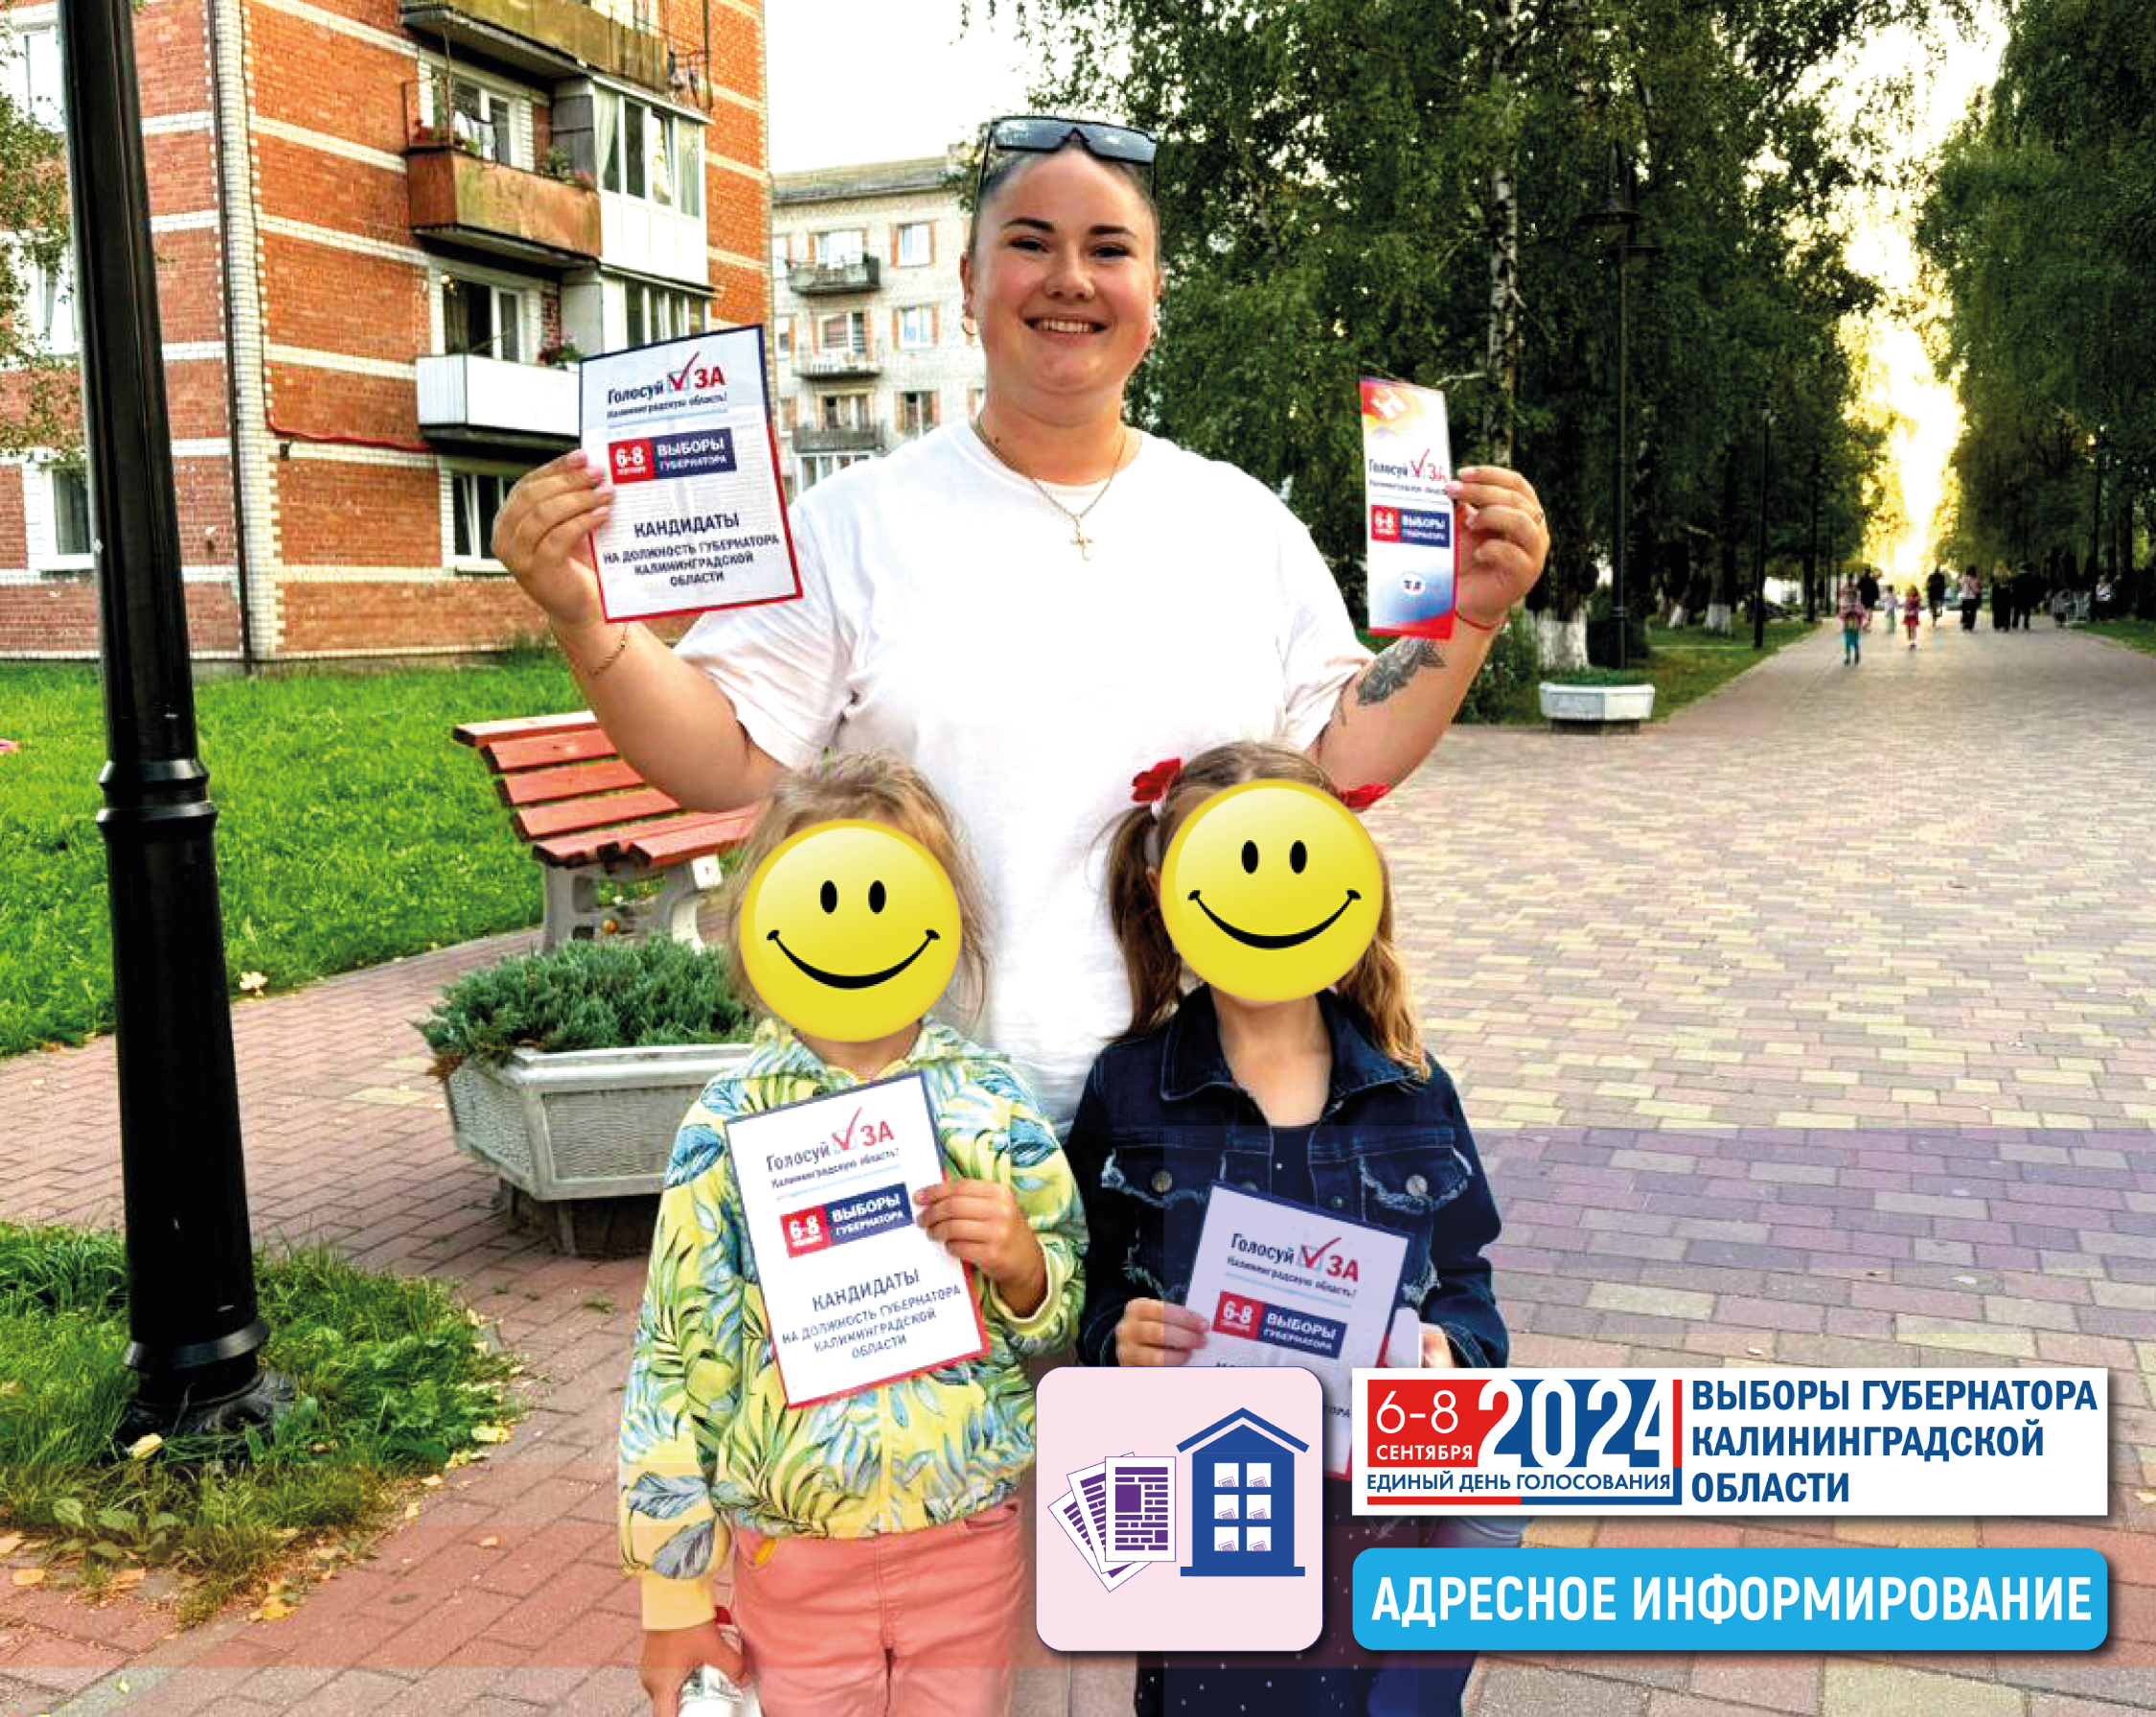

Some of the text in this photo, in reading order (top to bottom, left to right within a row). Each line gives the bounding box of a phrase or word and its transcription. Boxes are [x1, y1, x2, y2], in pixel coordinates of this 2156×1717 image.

[608, 366, 725, 405] Голосуй ЗА
[616, 446, 645, 468] 6-8
[656, 437, 724, 458] ВЫБОРЫ
[658, 454, 727, 471] ГУБЕРНАТОРА
[634, 513, 740, 538] КАНДИДАТЫ
[604, 533, 779, 565] НА ДОЛЖНОСТЬ ГУБЕРНАТОРА
[634, 551, 754, 576] КАЛИНИНГРАДСКОЙ
[670, 570, 724, 587] ОБЛАСТИ
[767, 1120, 895, 1173] Голосуй ЗА
[832, 1193, 900, 1224] ВЫБОРЫ
[790, 1215, 820, 1241] 6-8
[836, 1210, 904, 1237] ГУБЕРНАТОРА
[1230, 1232, 1359, 1282] Голосуй ЗА
[812, 1269, 920, 1313] КАНДИДАТЫ
[782, 1284, 961, 1344] НА ДОЛЖНОСТЬ ГУБЕРНАТОРА
[1223, 1300, 1253, 1325] 6-8
[1266, 1312, 1337, 1340] ВЫБОРЫ
[814, 1307, 937, 1353] КАЛИНИНГРАДСКОЙ
[851, 1334, 907, 1360] ОБЛАСТИ
